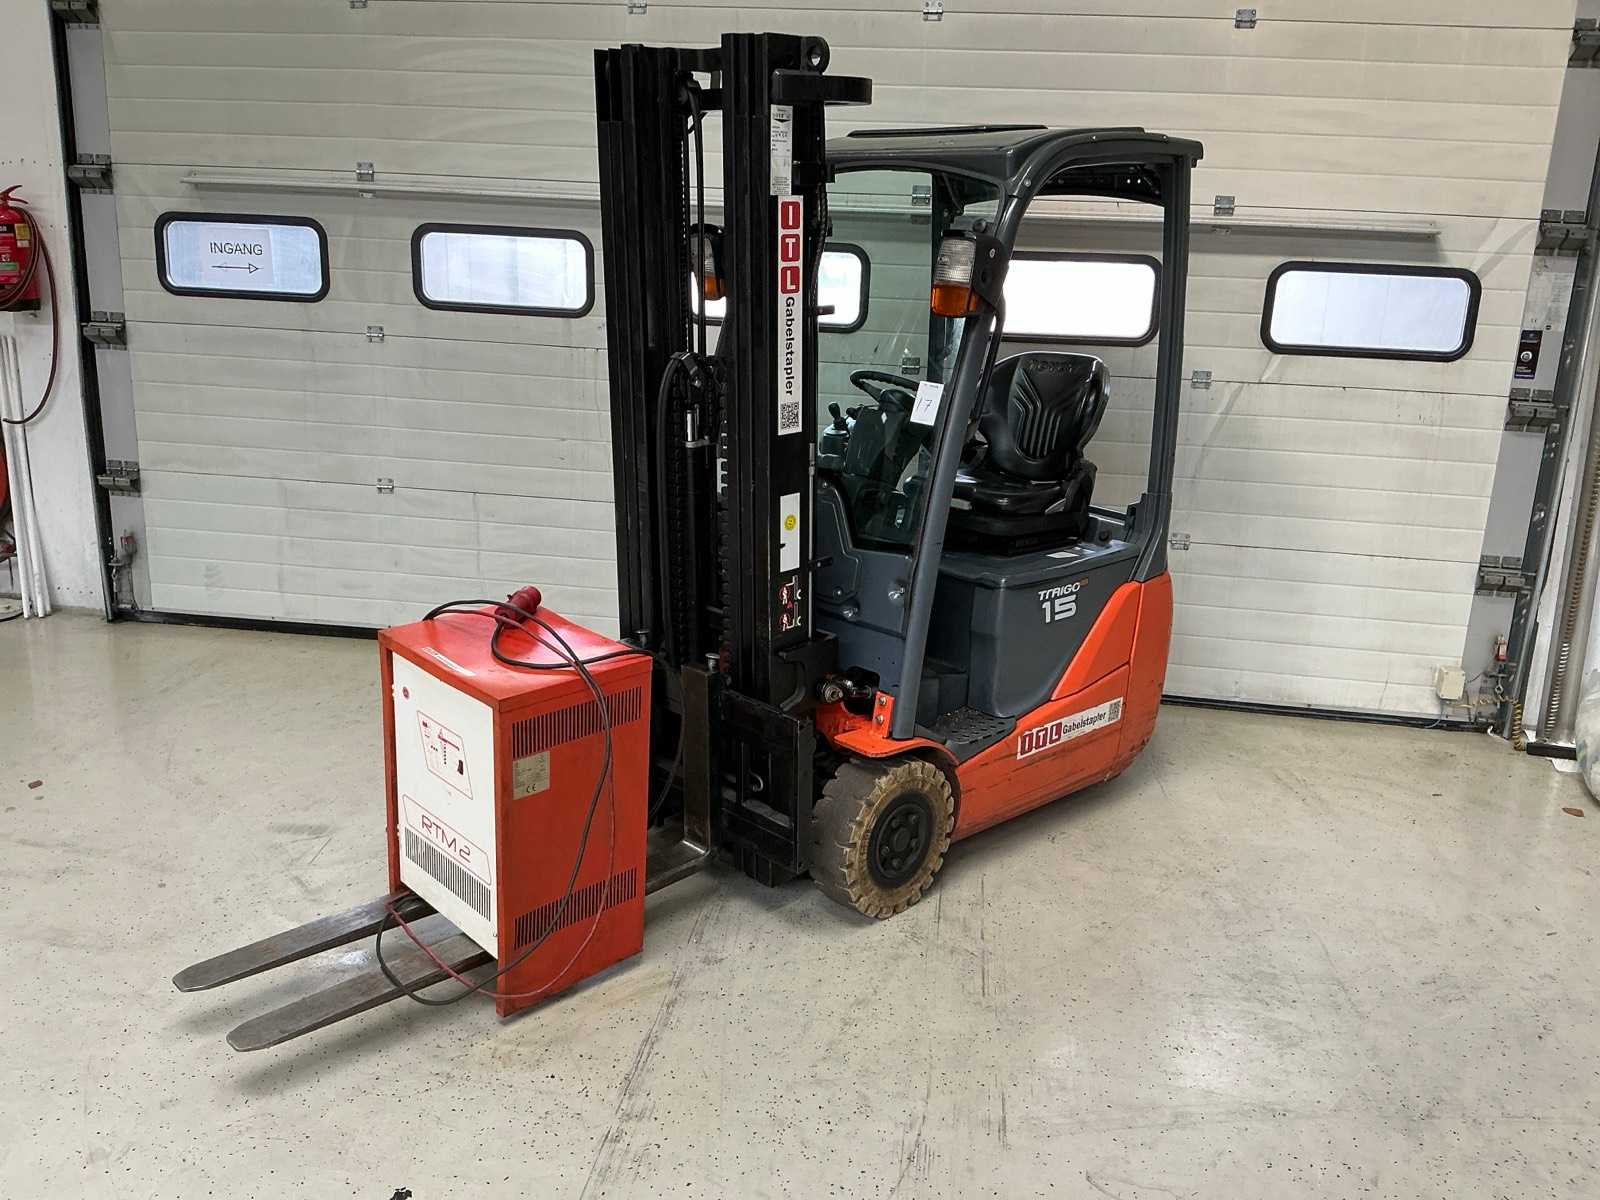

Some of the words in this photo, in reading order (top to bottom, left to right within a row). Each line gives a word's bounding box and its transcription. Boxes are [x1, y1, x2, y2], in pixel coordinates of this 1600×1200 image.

[210, 242, 263, 256] INGANG
[784, 204, 797, 291] ITL
[784, 296, 795, 396] Gabelstapler
[1042, 594, 1077, 623] 15
[1023, 723, 1060, 753] ITL
[1062, 711, 1107, 735] Gabelstapler
